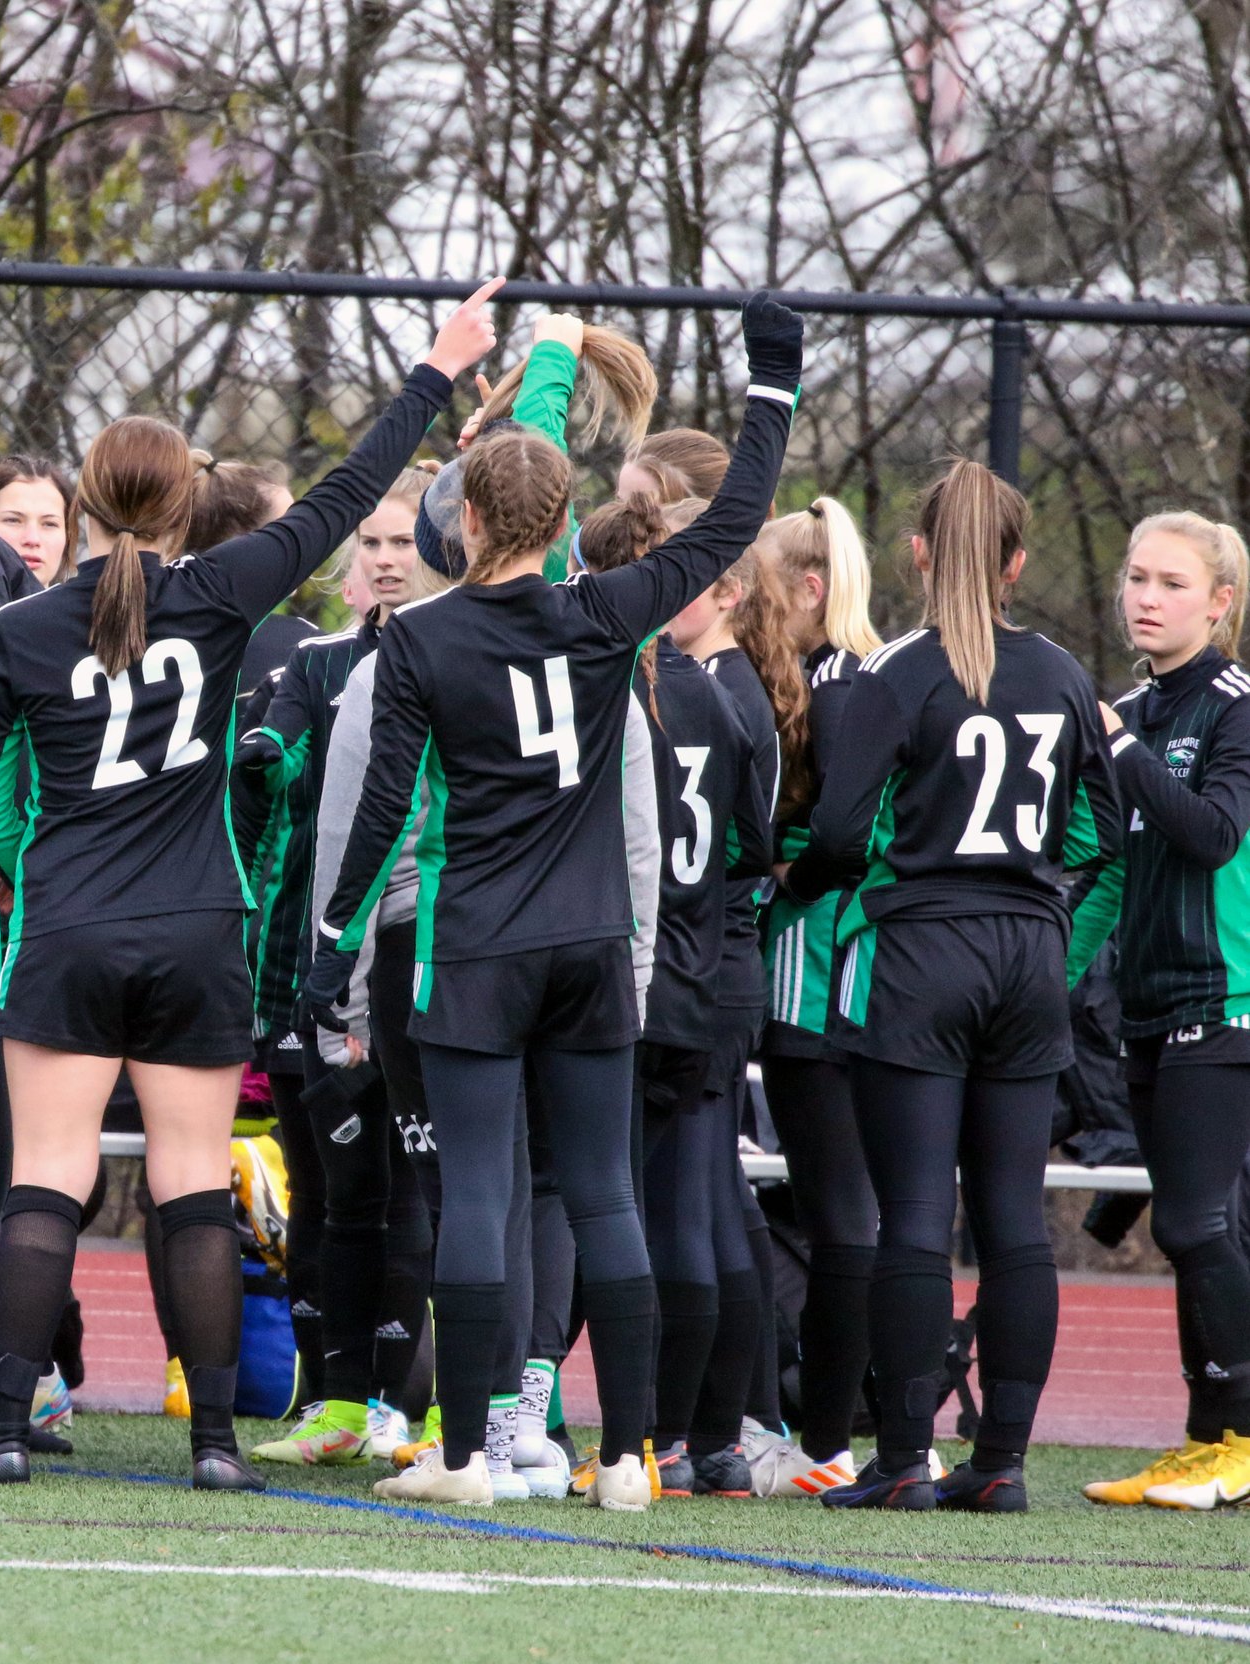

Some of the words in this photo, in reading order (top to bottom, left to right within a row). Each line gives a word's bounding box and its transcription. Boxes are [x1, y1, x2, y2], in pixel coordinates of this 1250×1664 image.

[71, 638, 209, 790] 22
[508, 655, 580, 789] 4
[956, 713, 1065, 854] 23
[671, 746, 712, 885] 3
